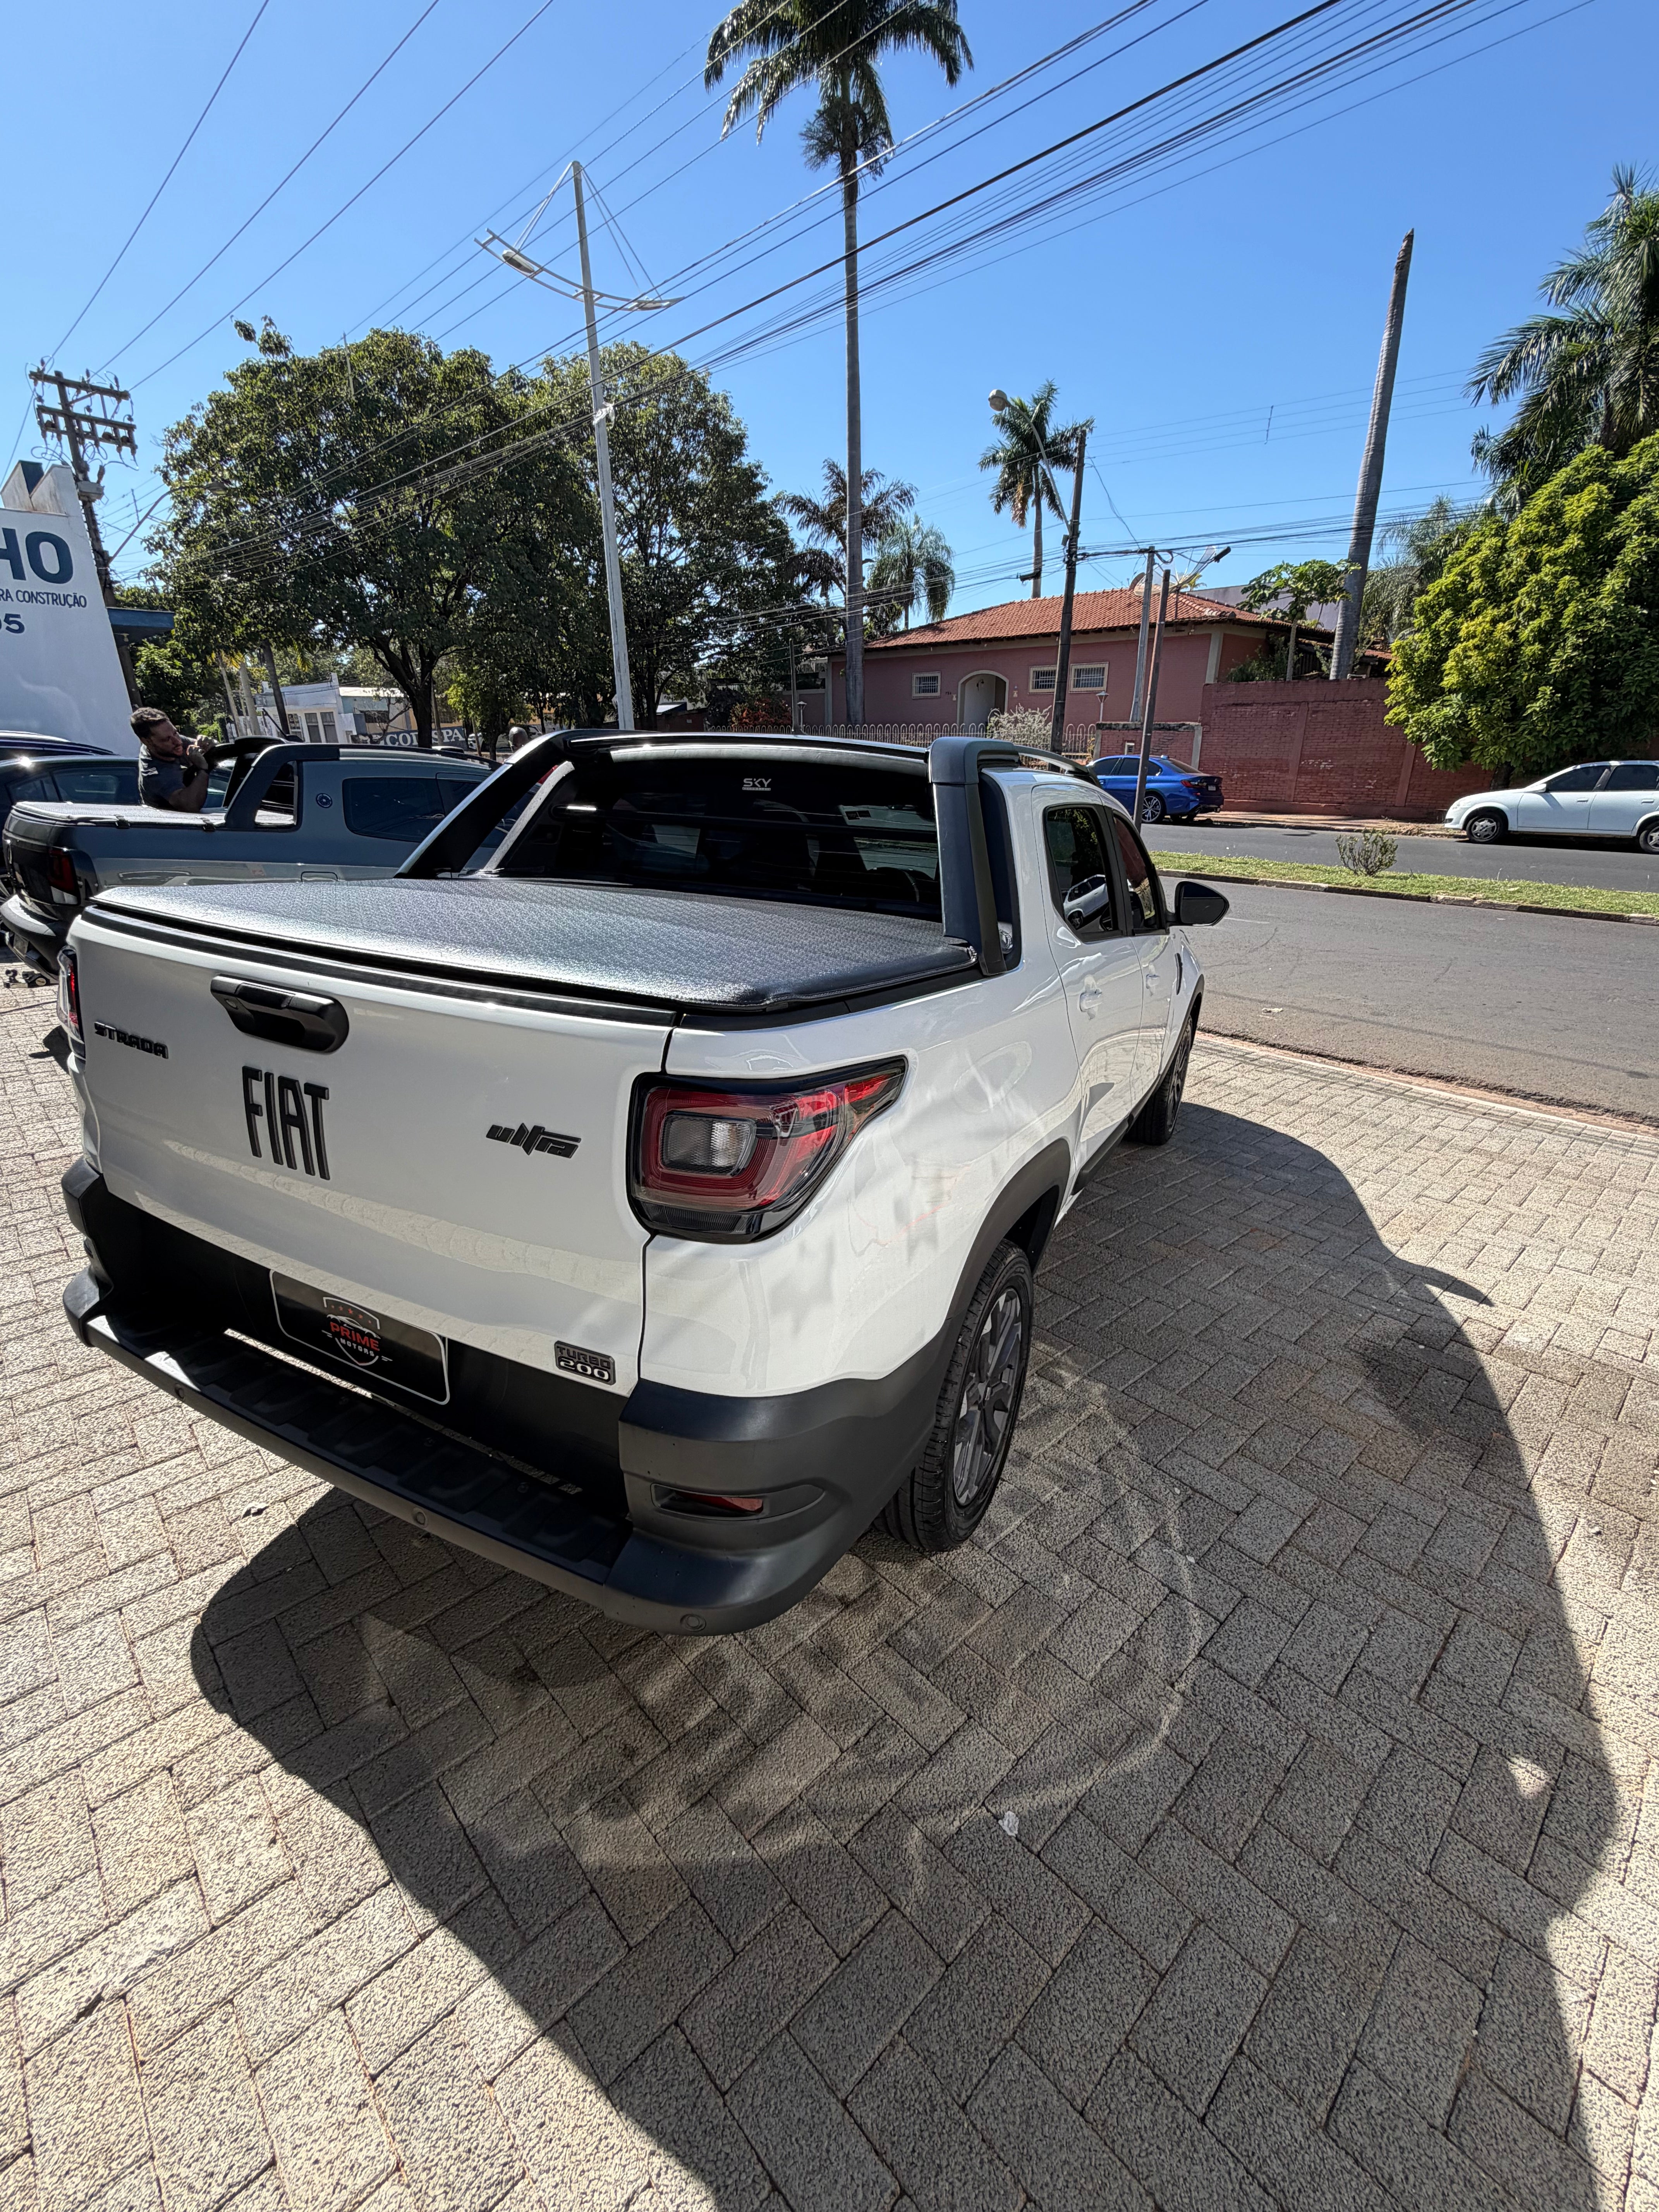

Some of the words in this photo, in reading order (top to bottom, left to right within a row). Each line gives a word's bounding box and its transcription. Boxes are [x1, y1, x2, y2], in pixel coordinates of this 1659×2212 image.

[16, 589, 87, 608] CONSTRUÇÃO
[743, 778, 772, 787] SKY
[94, 1021, 168, 1059] STRADA
[242, 1065, 330, 1180] FIAT
[330, 1322, 380, 1351] PRIME
[340, 1338, 374, 1357] MOTORS
[556, 1346, 611, 1369] TURBO
[559, 1357, 610, 1381] 200
